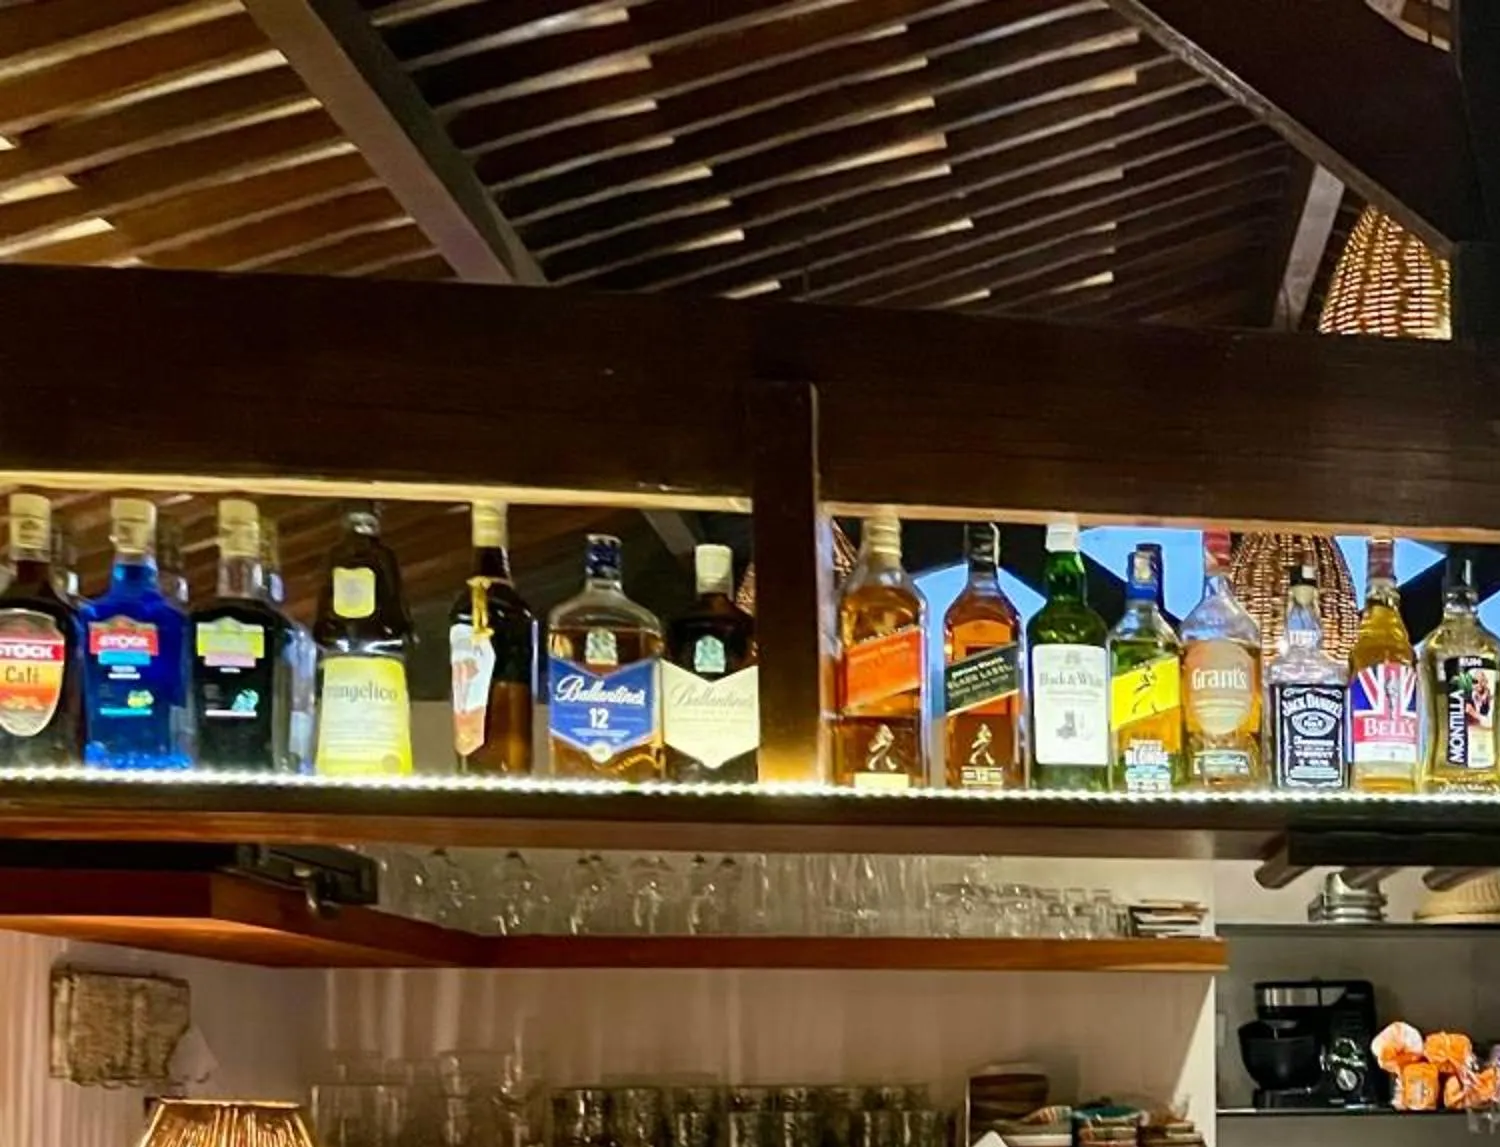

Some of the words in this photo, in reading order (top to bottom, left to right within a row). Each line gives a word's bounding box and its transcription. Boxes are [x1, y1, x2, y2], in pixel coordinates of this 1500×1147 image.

[98, 633, 150, 650] STOCK
[1192, 665, 1249, 691] Grant's
[588, 707, 610, 730] 12
[1448, 688, 1466, 764] MONTILLA
